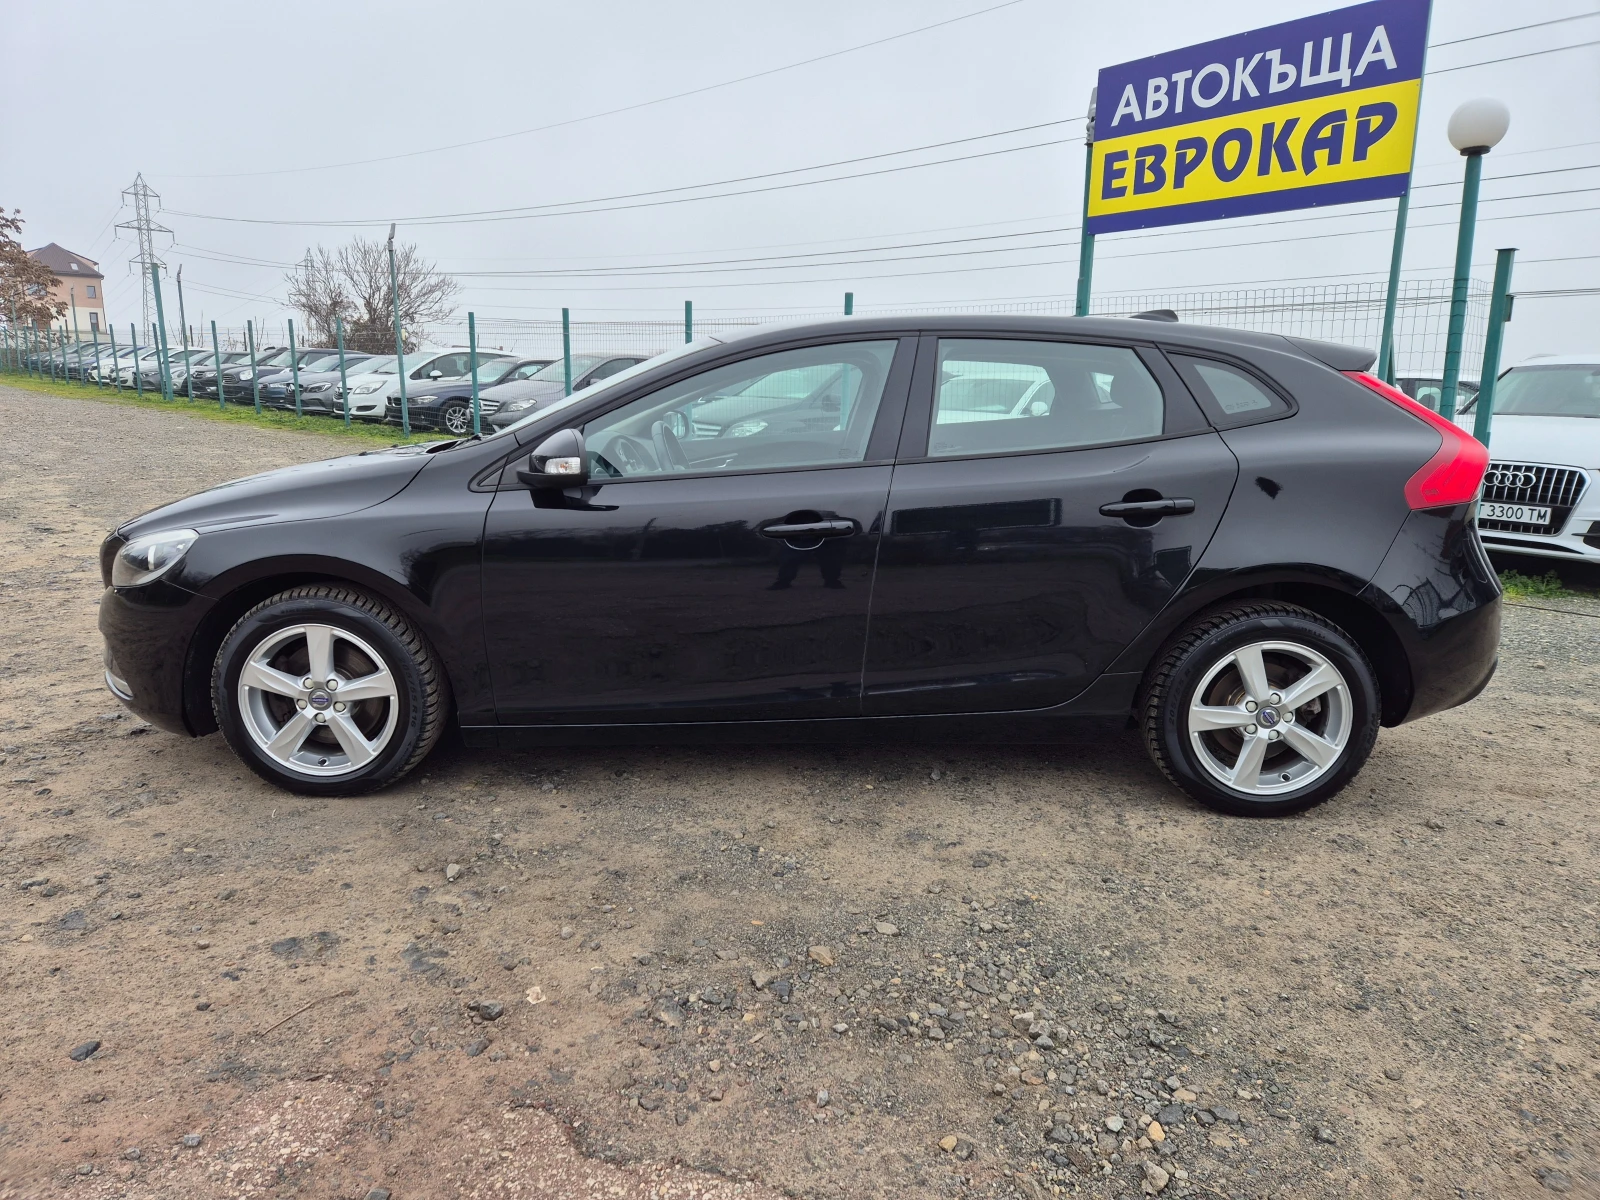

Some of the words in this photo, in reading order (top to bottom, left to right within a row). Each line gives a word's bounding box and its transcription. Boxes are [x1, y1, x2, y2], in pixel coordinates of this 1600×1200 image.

[1111, 25, 1398, 127] АВТОКЪЩА
[1101, 101, 1398, 200] ЕВРОКАР
[1487, 504, 1523, 520] 3300
[1528, 507, 1548, 522] TM
